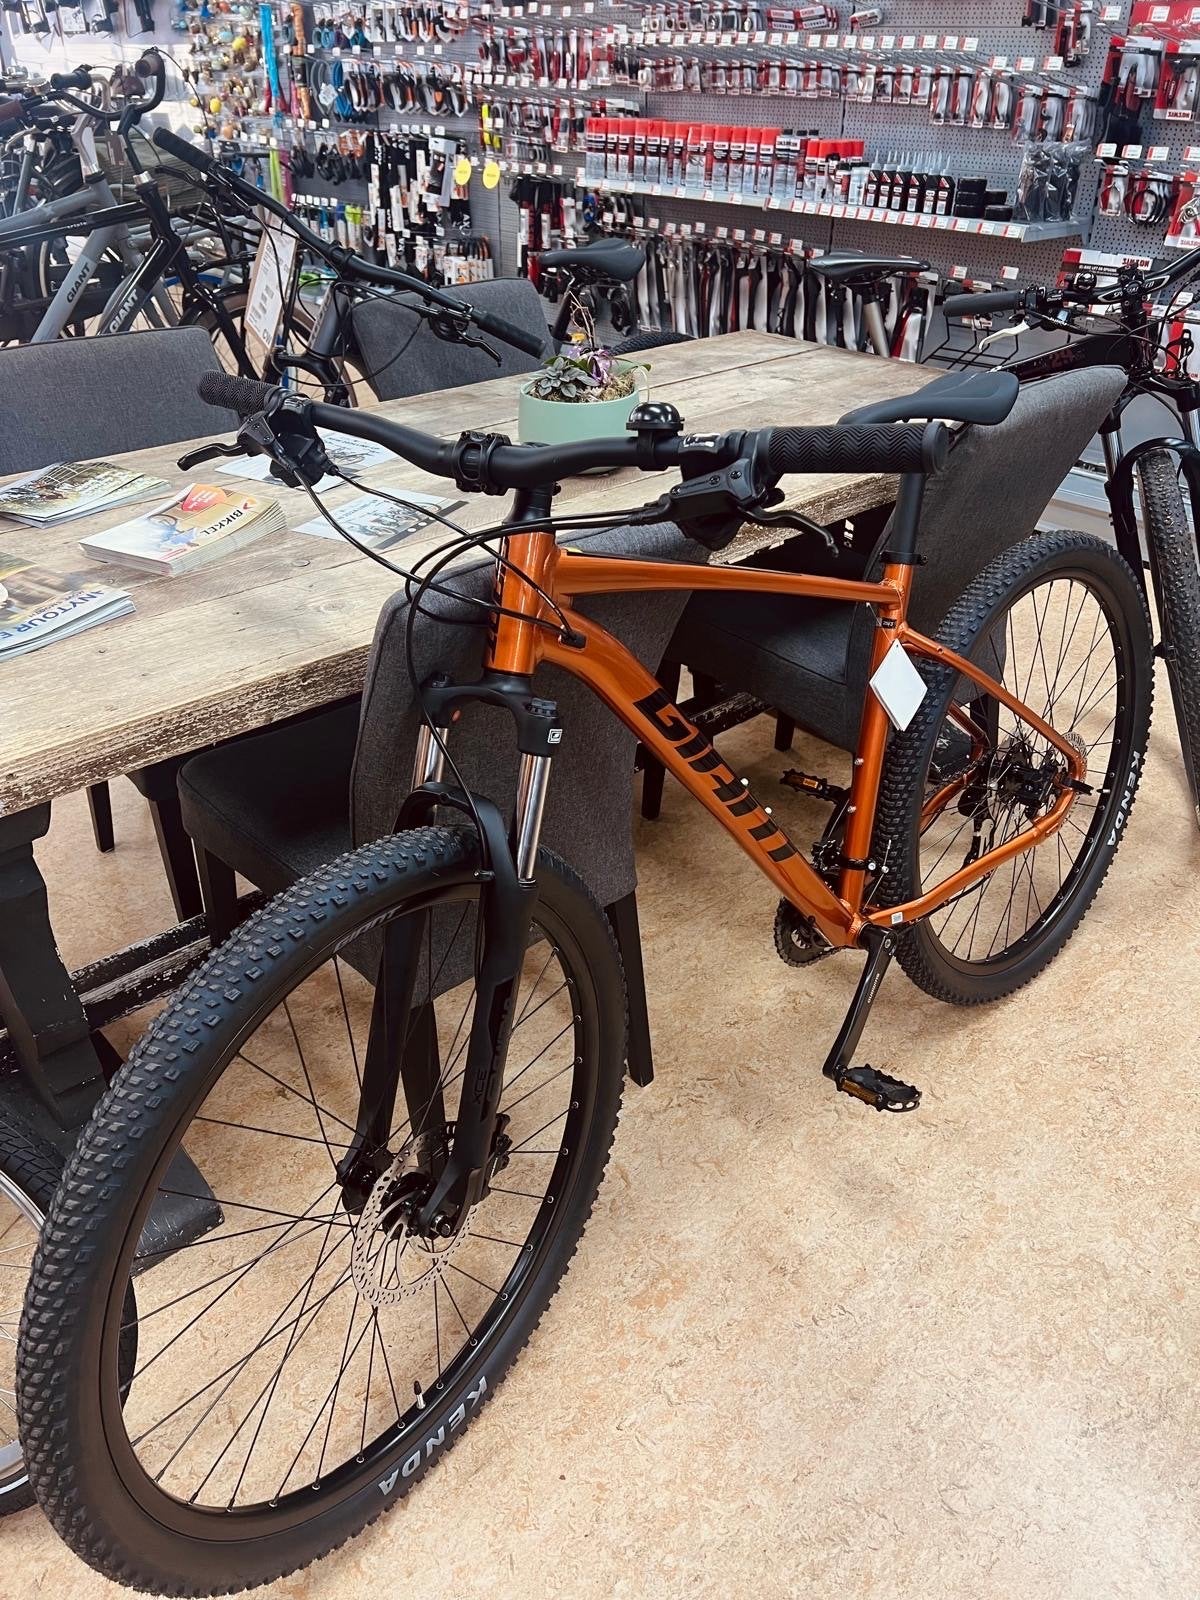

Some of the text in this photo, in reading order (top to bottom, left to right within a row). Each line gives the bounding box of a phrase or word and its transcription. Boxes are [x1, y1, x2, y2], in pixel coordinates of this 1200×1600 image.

[66, 263, 91, 304] GIANT
[109, 289, 138, 333] GIANT
[200, 508, 243, 536] BIKKEL
[1107, 751, 1141, 846] KENDA
[378, 1375, 488, 1496] KENDA
